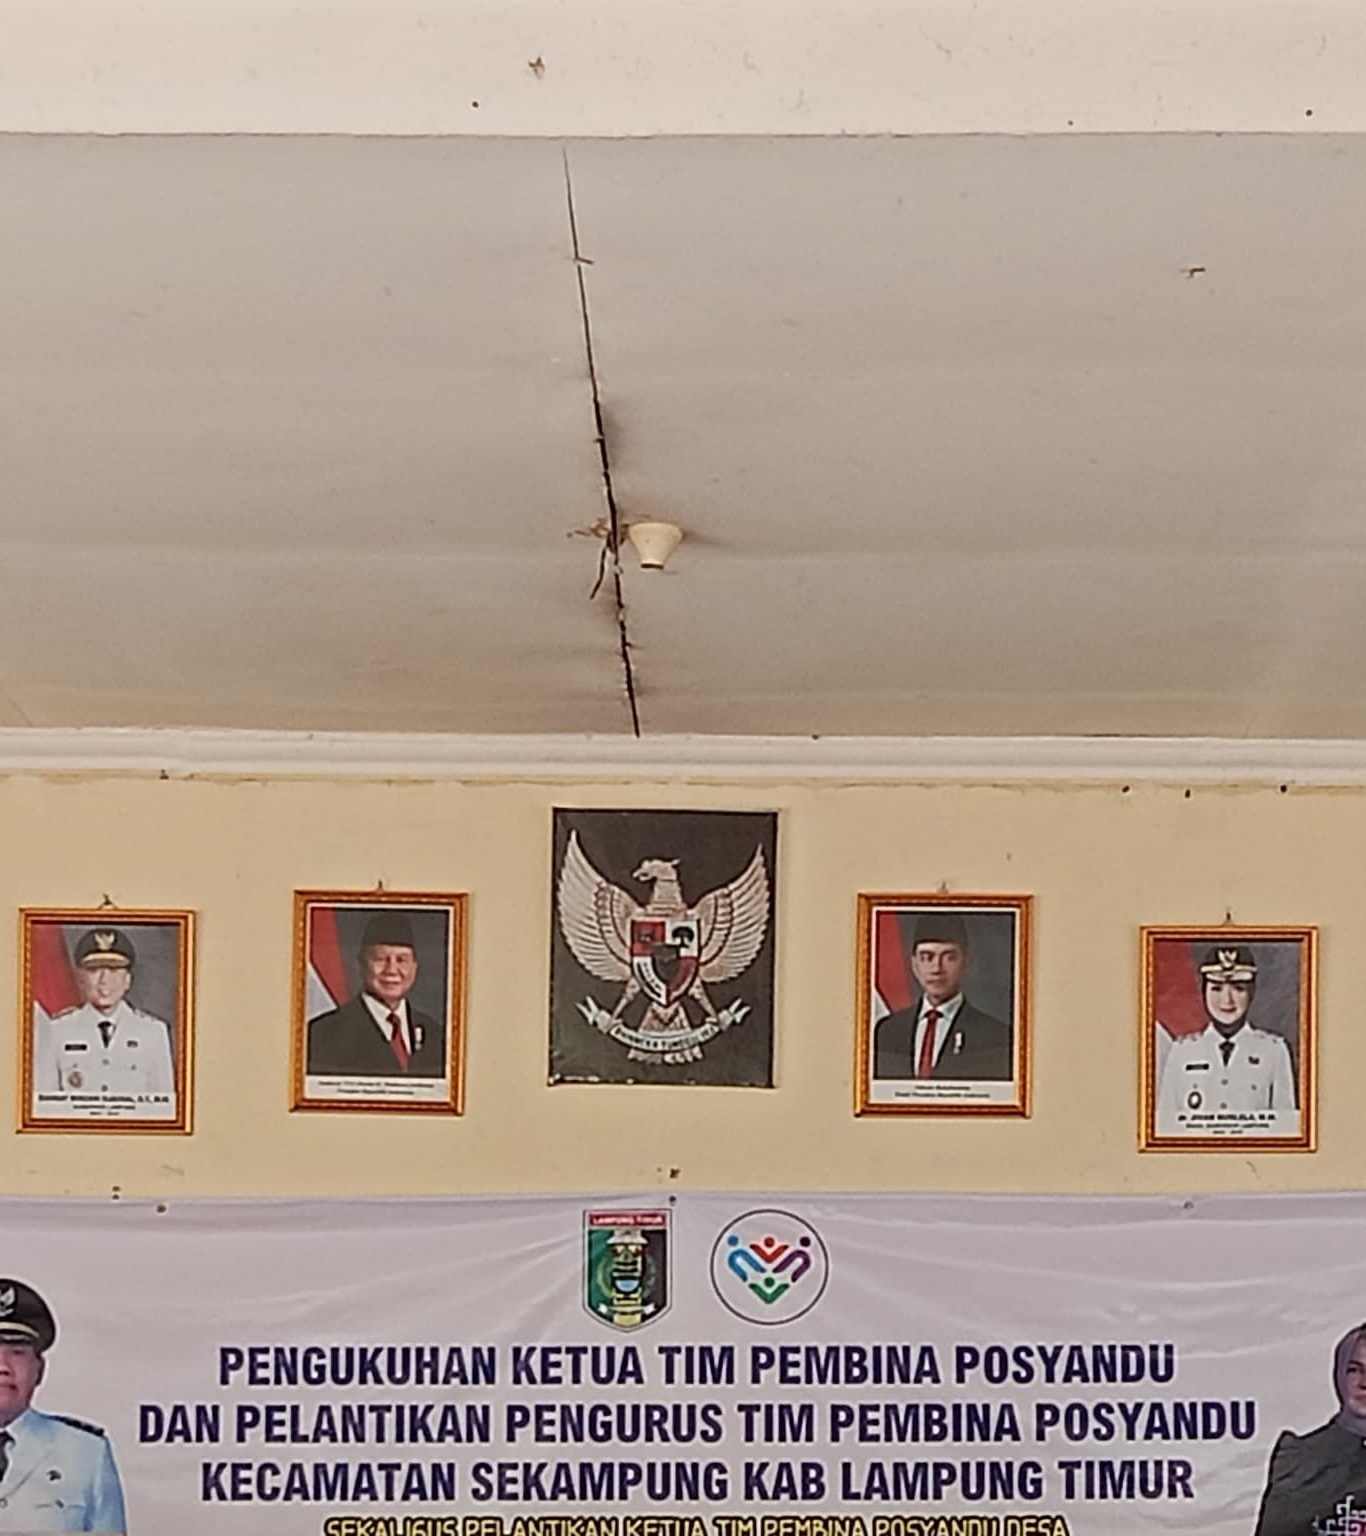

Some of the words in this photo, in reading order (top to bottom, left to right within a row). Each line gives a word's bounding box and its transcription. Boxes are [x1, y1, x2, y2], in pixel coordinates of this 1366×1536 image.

[219, 1346, 496, 1386] PENGUKUHAN
[512, 1346, 645, 1385] KETUA
[657, 1346, 735, 1385] TIM
[750, 1345, 941, 1385] PEMBINA
[954, 1344, 1176, 1384] POSYANDU
[138, 1404, 221, 1443] DAN
[236, 1403, 491, 1443] PELANTIKAN
[506, 1403, 724, 1443] PENGURUS
[738, 1404, 815, 1442] TIM
[829, 1402, 1022, 1442] PEMBINA
[1035, 1401, 1256, 1442] POSYANDU
[201, 1461, 457, 1501] KECAMATAN
[471, 1461, 729, 1501] SEKAMPUNG
[743, 1461, 826, 1501] KAB
[841, 1461, 1044, 1501] LAMPUNG
[1058, 1460, 1195, 1500] TIMUR
